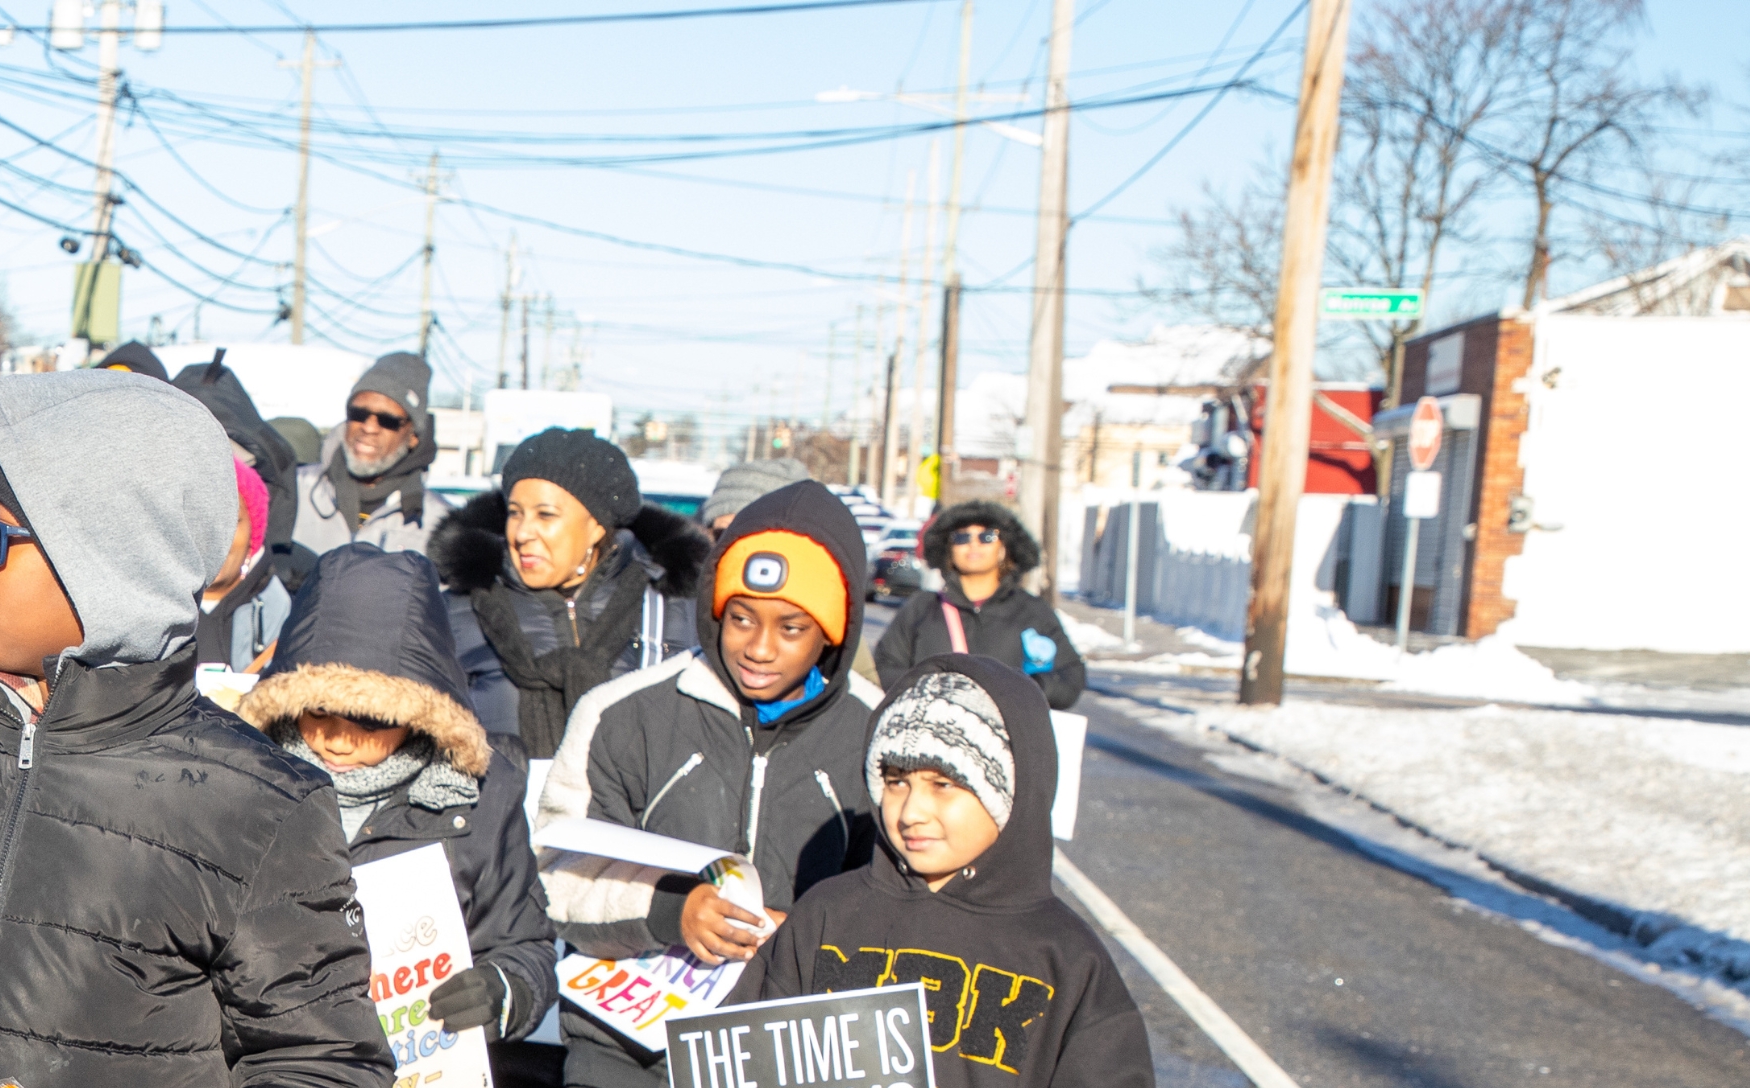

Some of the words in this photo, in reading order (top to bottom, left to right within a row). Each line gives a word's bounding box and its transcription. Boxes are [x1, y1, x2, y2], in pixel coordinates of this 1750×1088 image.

[566, 958, 690, 1032] GREAT
[763, 1012, 866, 1088] TIME
[875, 1006, 916, 1077] IS
